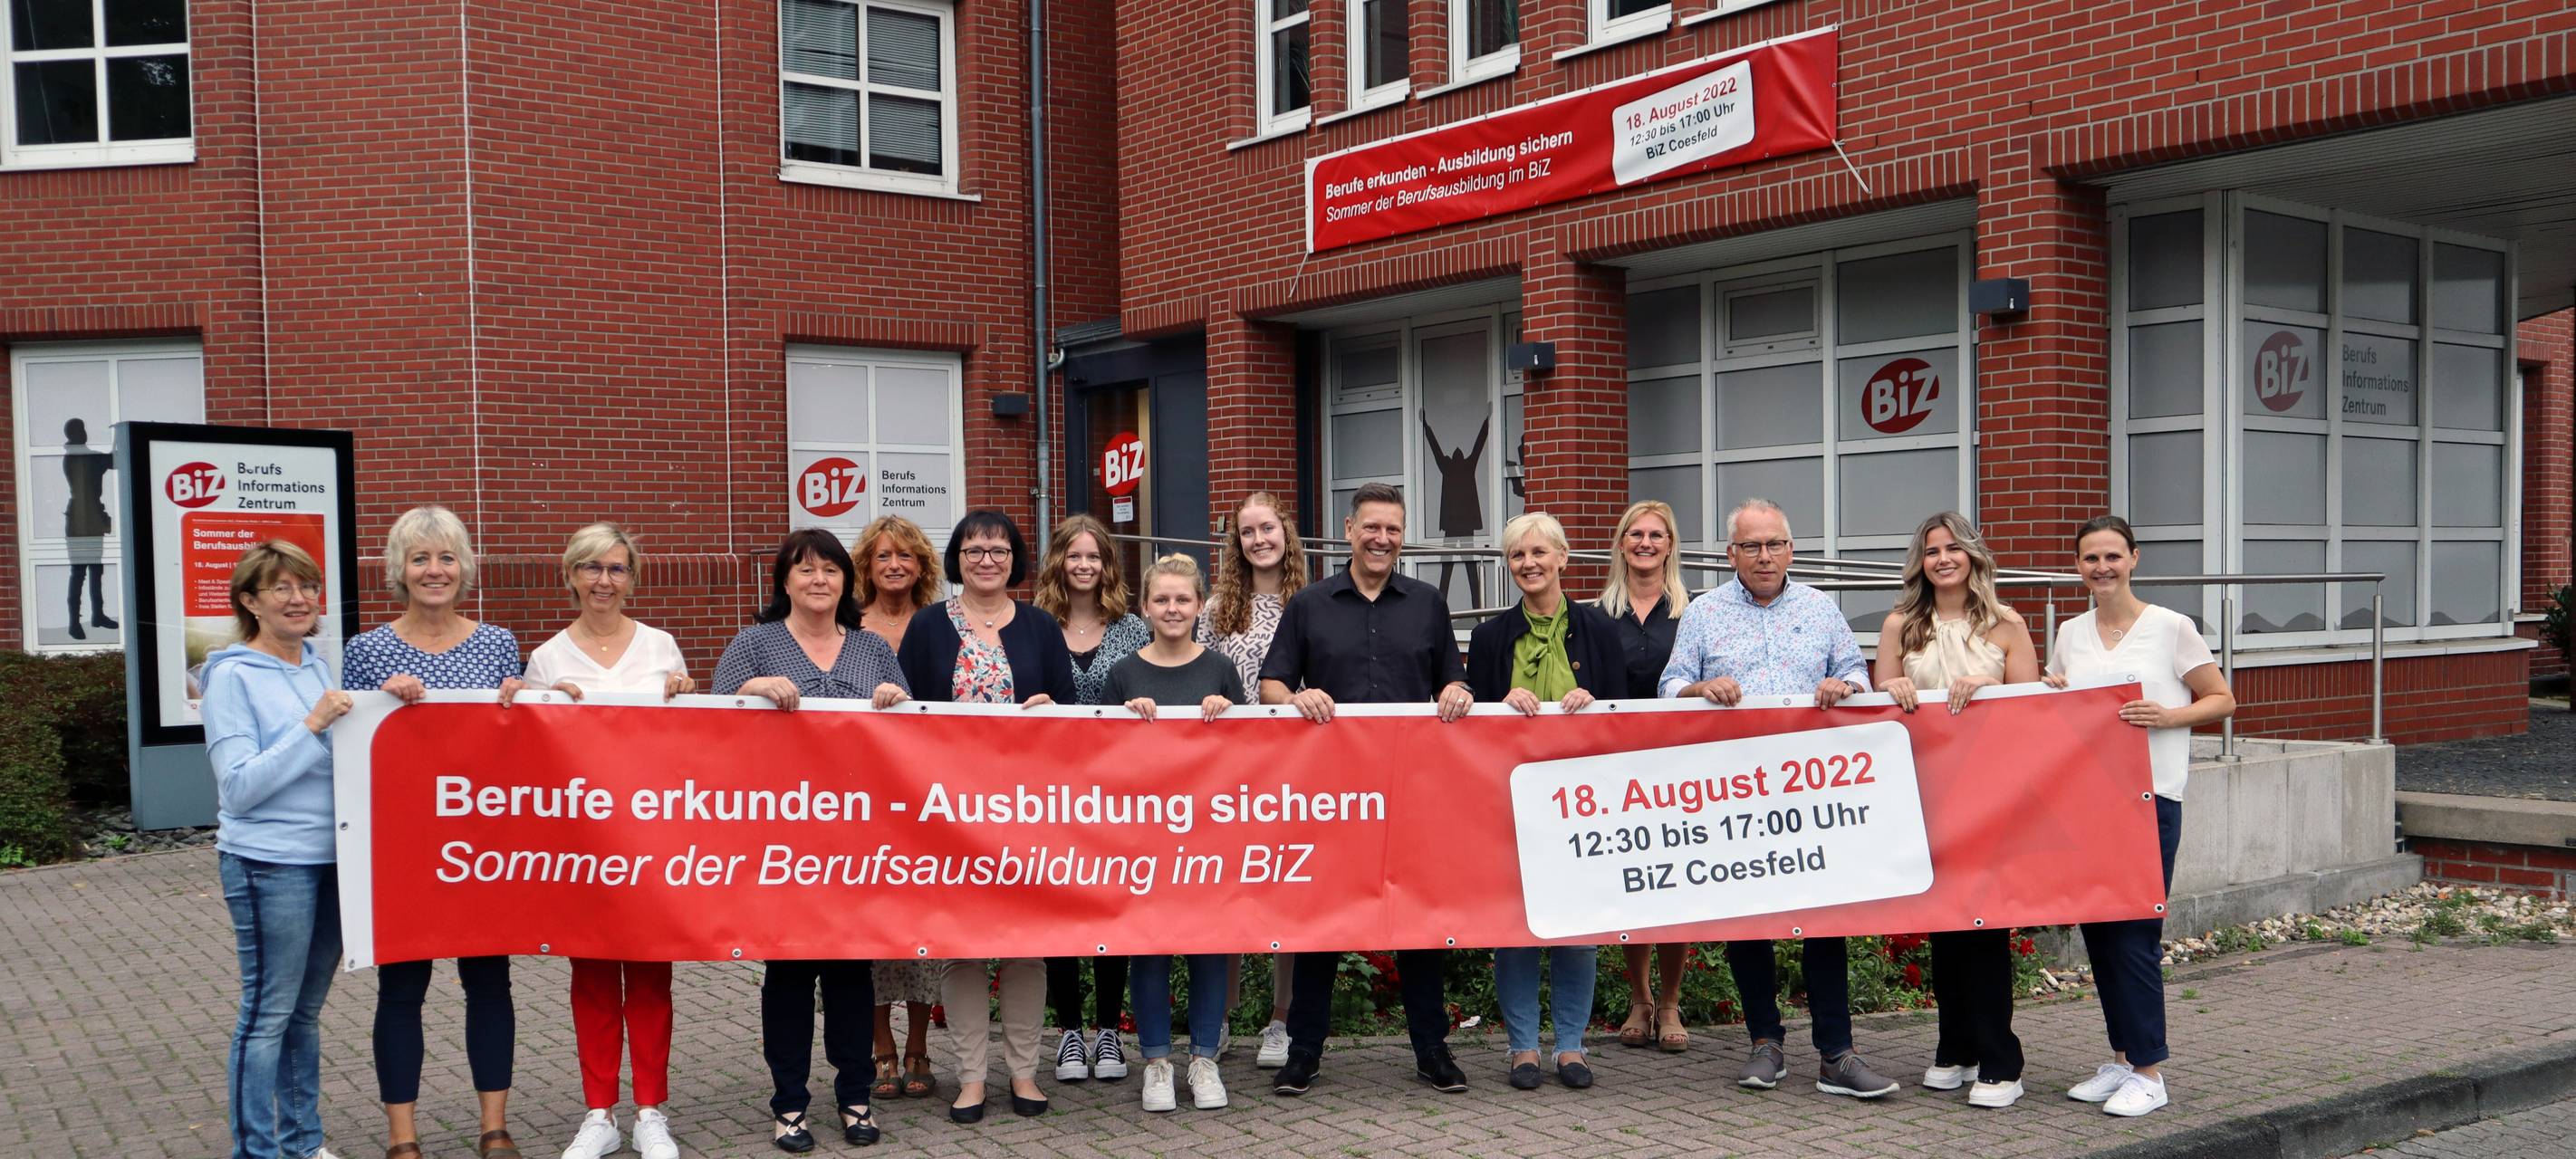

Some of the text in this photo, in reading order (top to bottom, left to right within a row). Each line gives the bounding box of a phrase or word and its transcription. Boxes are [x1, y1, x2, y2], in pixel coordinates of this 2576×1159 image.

[1626, 76, 1737, 130] 18. August 2022
[1630, 101, 1735, 147] 12:30 bis 17:00 Uhr
[1646, 125, 1717, 159] BiZ Coesfeld
[1325, 177, 1364, 199] Berufe
[1367, 165, 1427, 189] erkunden
[1437, 144, 1515, 174] Ausbildung
[1520, 130, 1573, 156] sichern
[1326, 158, 1552, 223] Sommer der Berufsausbildung im BiZ
[2261, 344, 2309, 399] BiZ
[2342, 344, 2377, 364] Berufs
[1871, 367, 1941, 425] BiZ
[2342, 369, 2409, 392] Informations
[2341, 396, 2387, 416] Zentrum
[172, 468, 225, 502] BiZ
[882, 470, 916, 481] Berufs
[1105, 440, 1144, 488] BiZ
[237, 479, 325, 493] Informations
[238, 497, 296, 509] Zentrum
[804, 466, 867, 509] BiZ
[882, 484, 947, 494] Informations
[882, 497, 925, 507] Zentrum
[193, 528, 255, 538] Sommer der
[193, 541, 262, 551] Berufsausbil
[436, 775, 1386, 833] Berufe erkunden - Ausbildung sichern
[1551, 752, 1876, 819] 18. August 2022
[1568, 801, 1870, 858] 12:30 bis 17:00 Uhr
[436, 840, 1314, 895] Sommer der Berufsausbildung im BiZ
[1622, 846, 1826, 893] BiZ Coesfeld
